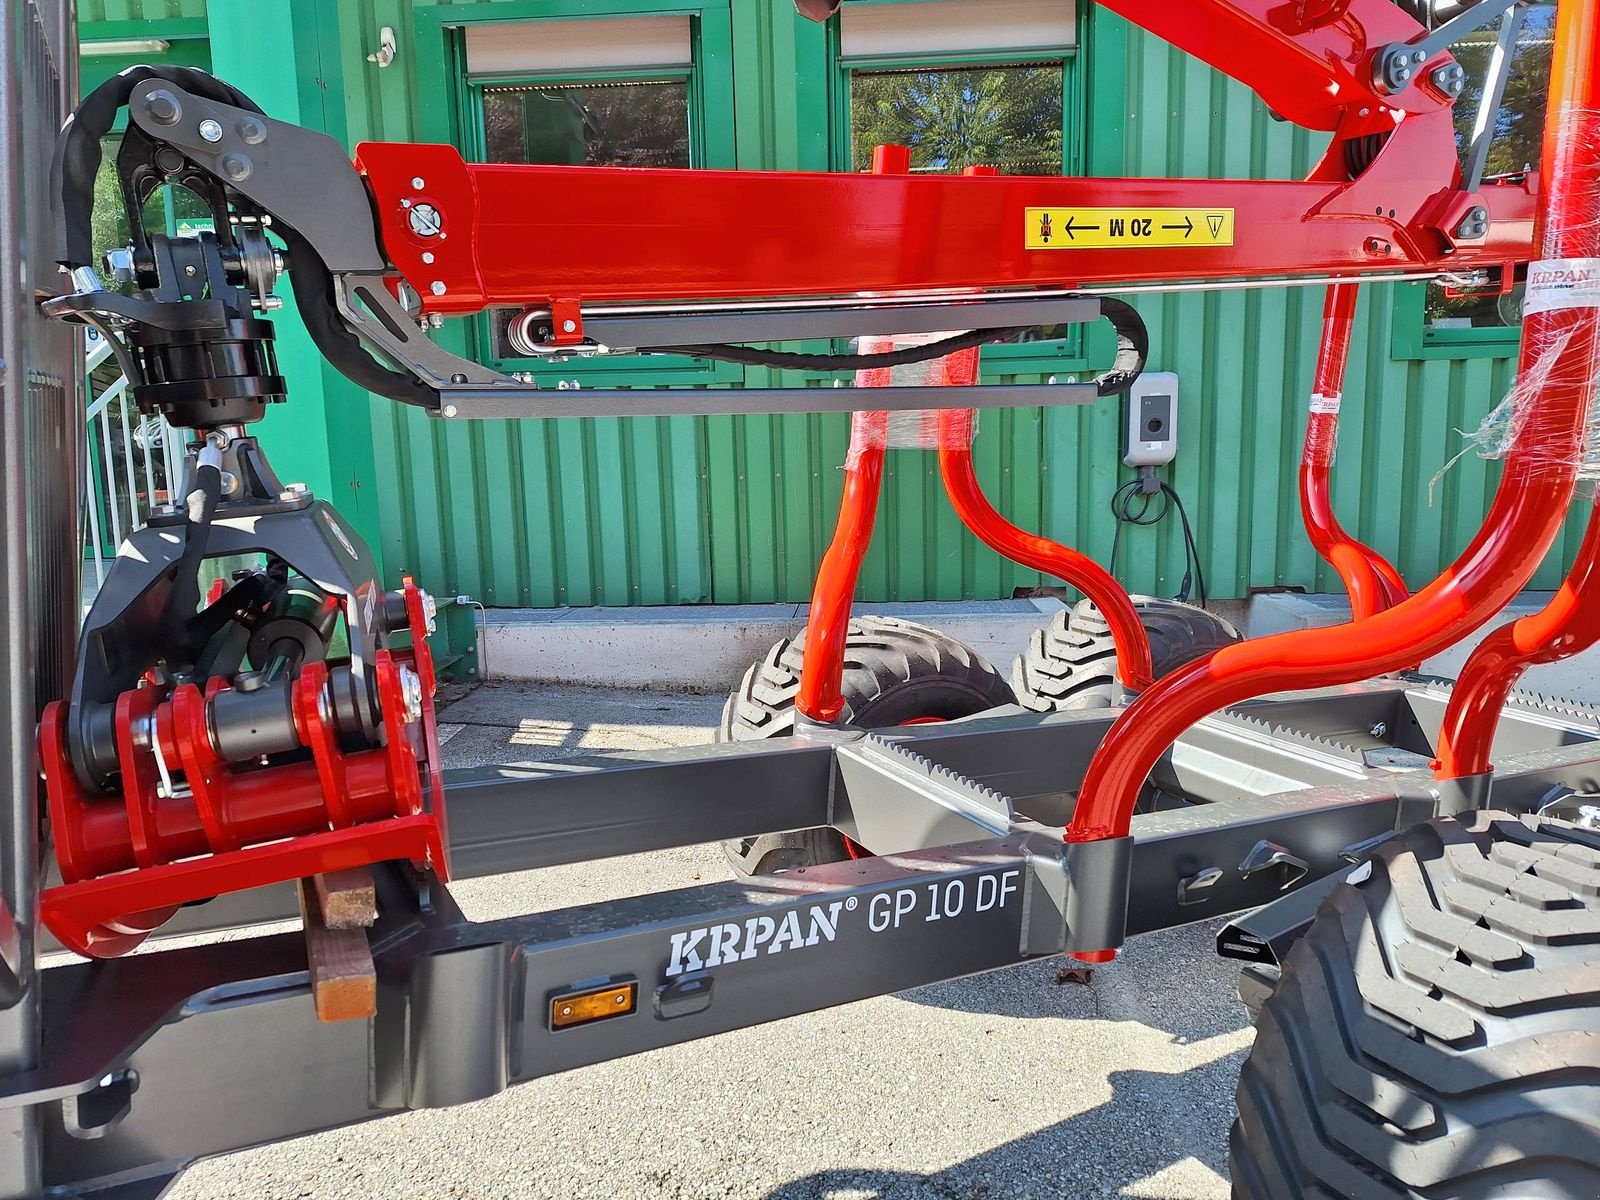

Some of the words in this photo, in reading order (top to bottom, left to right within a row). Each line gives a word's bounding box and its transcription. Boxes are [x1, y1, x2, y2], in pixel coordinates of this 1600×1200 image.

[1109, 218, 1125, 237] M
[1130, 218, 1153, 237] 20
[868, 888, 917, 933] GP
[925, 879, 965, 922] 10
[975, 870, 1020, 913] DF
